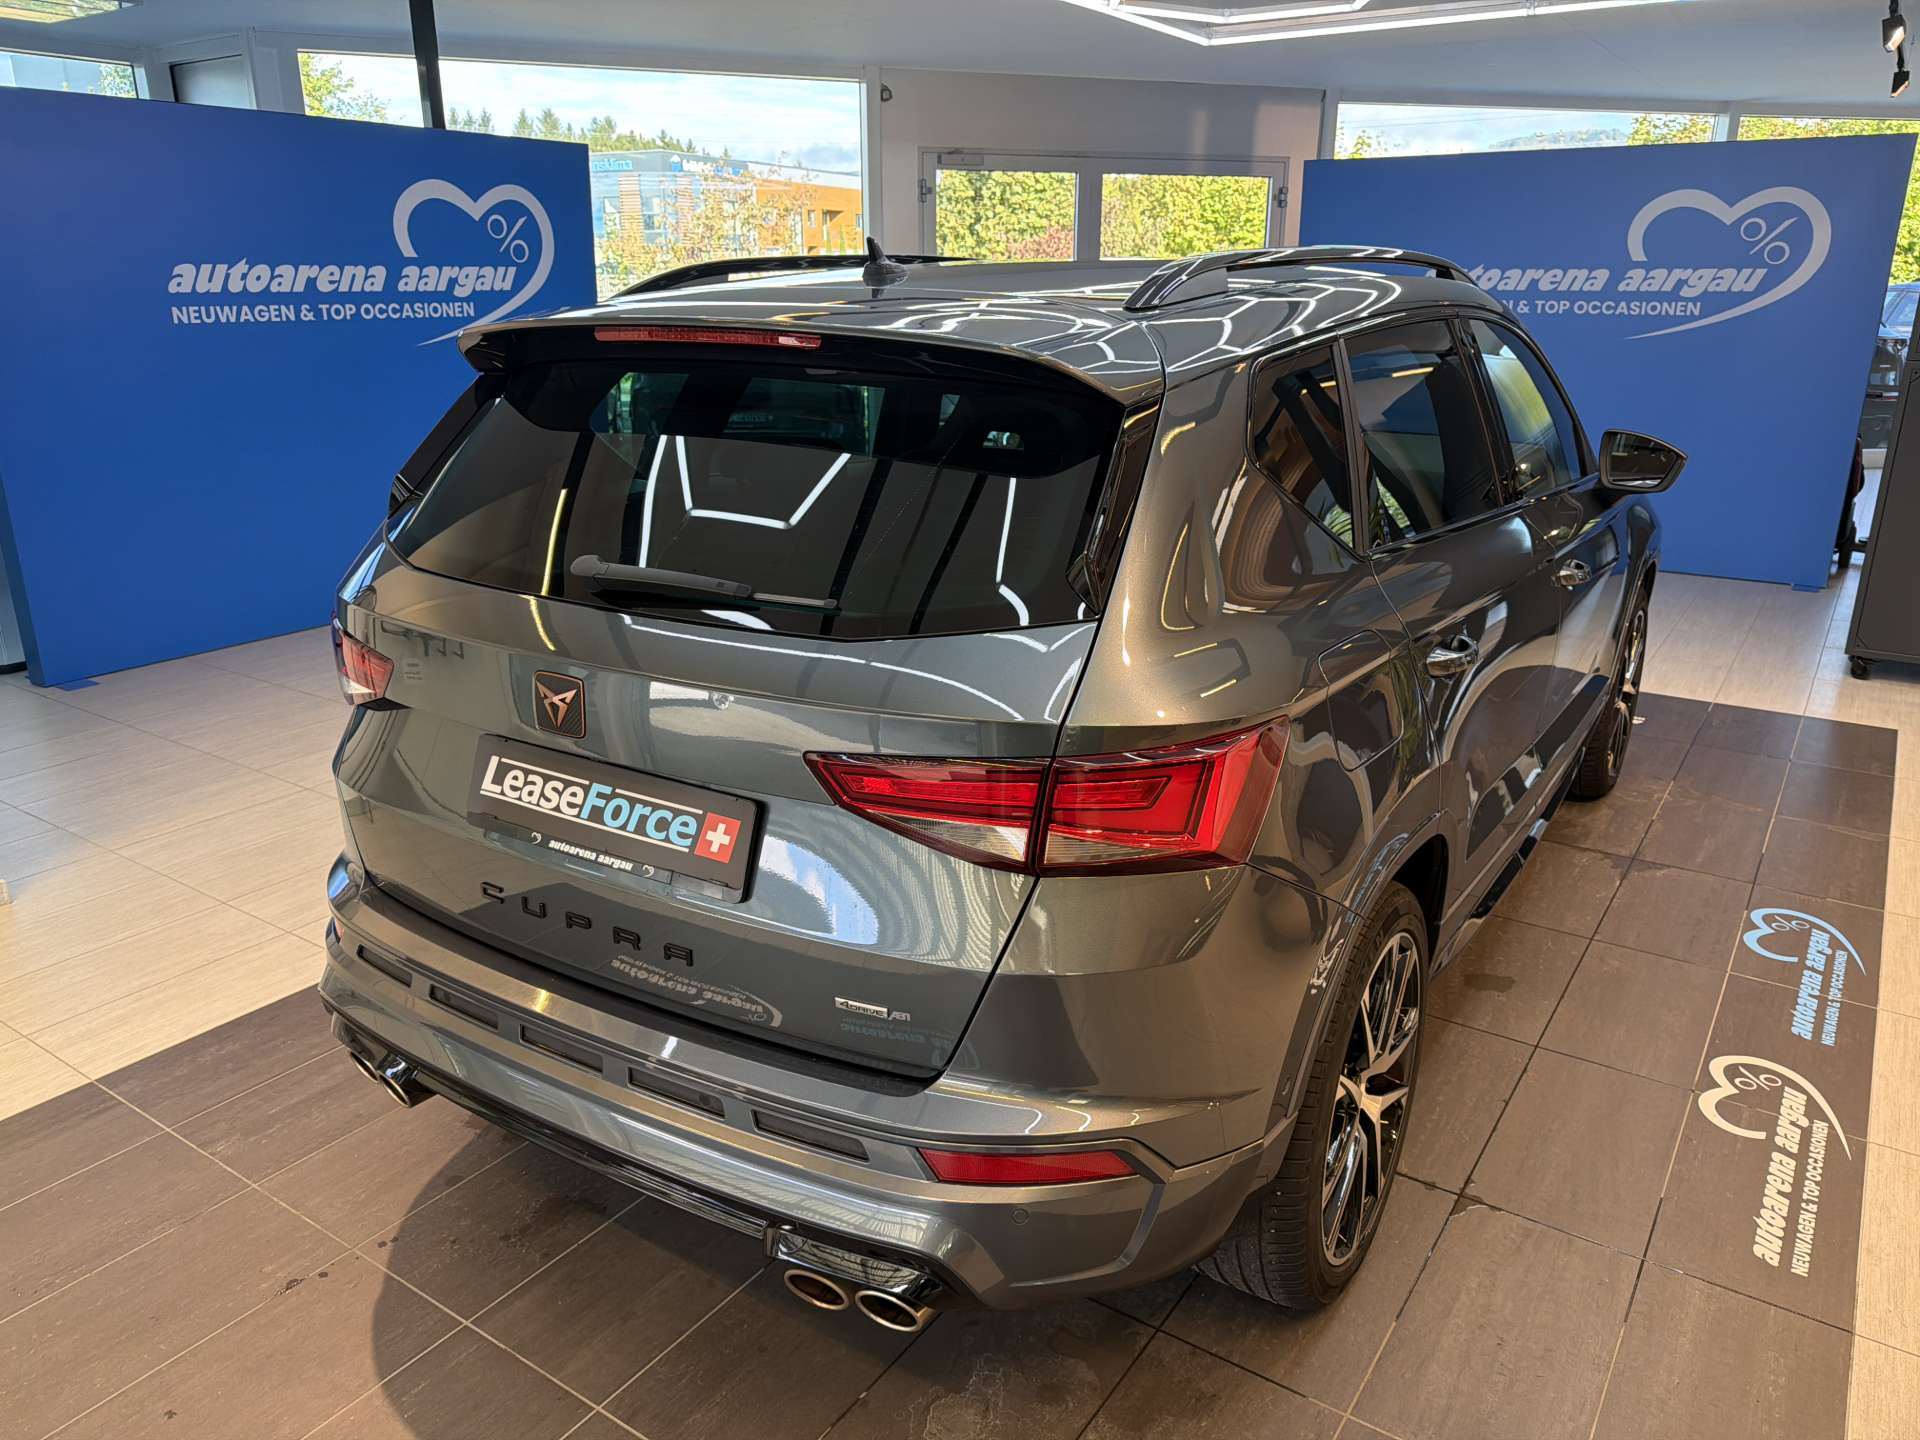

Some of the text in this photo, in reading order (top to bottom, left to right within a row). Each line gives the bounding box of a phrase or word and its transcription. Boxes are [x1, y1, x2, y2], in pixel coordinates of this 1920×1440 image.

[168, 257, 517, 298] autoarena aargau
[1464, 264, 1769, 298] toarena aargau
[171, 301, 475, 324] NEUWAGEN & TOP OCCASIONEN
[1517, 300, 1530, 314] &
[1534, 300, 1570, 315] TOP
[1574, 300, 1701, 316] OCCASIONEN
[480, 755, 698, 846] LeaseForce
[548, 839, 634, 871] autoarena aargau
[480, 881, 694, 967] CUPRA
[1790, 928, 1833, 1041] autoarena aargau
[1830, 949, 1848, 988] OCCASIONEN
[1821, 1006, 1840, 1047] NEUWAGEN
[1752, 1086, 1810, 1267] autoarena aargau
[1791, 1119, 1829, 1277] NEUWAGEN & TOP OCCASIONEN
